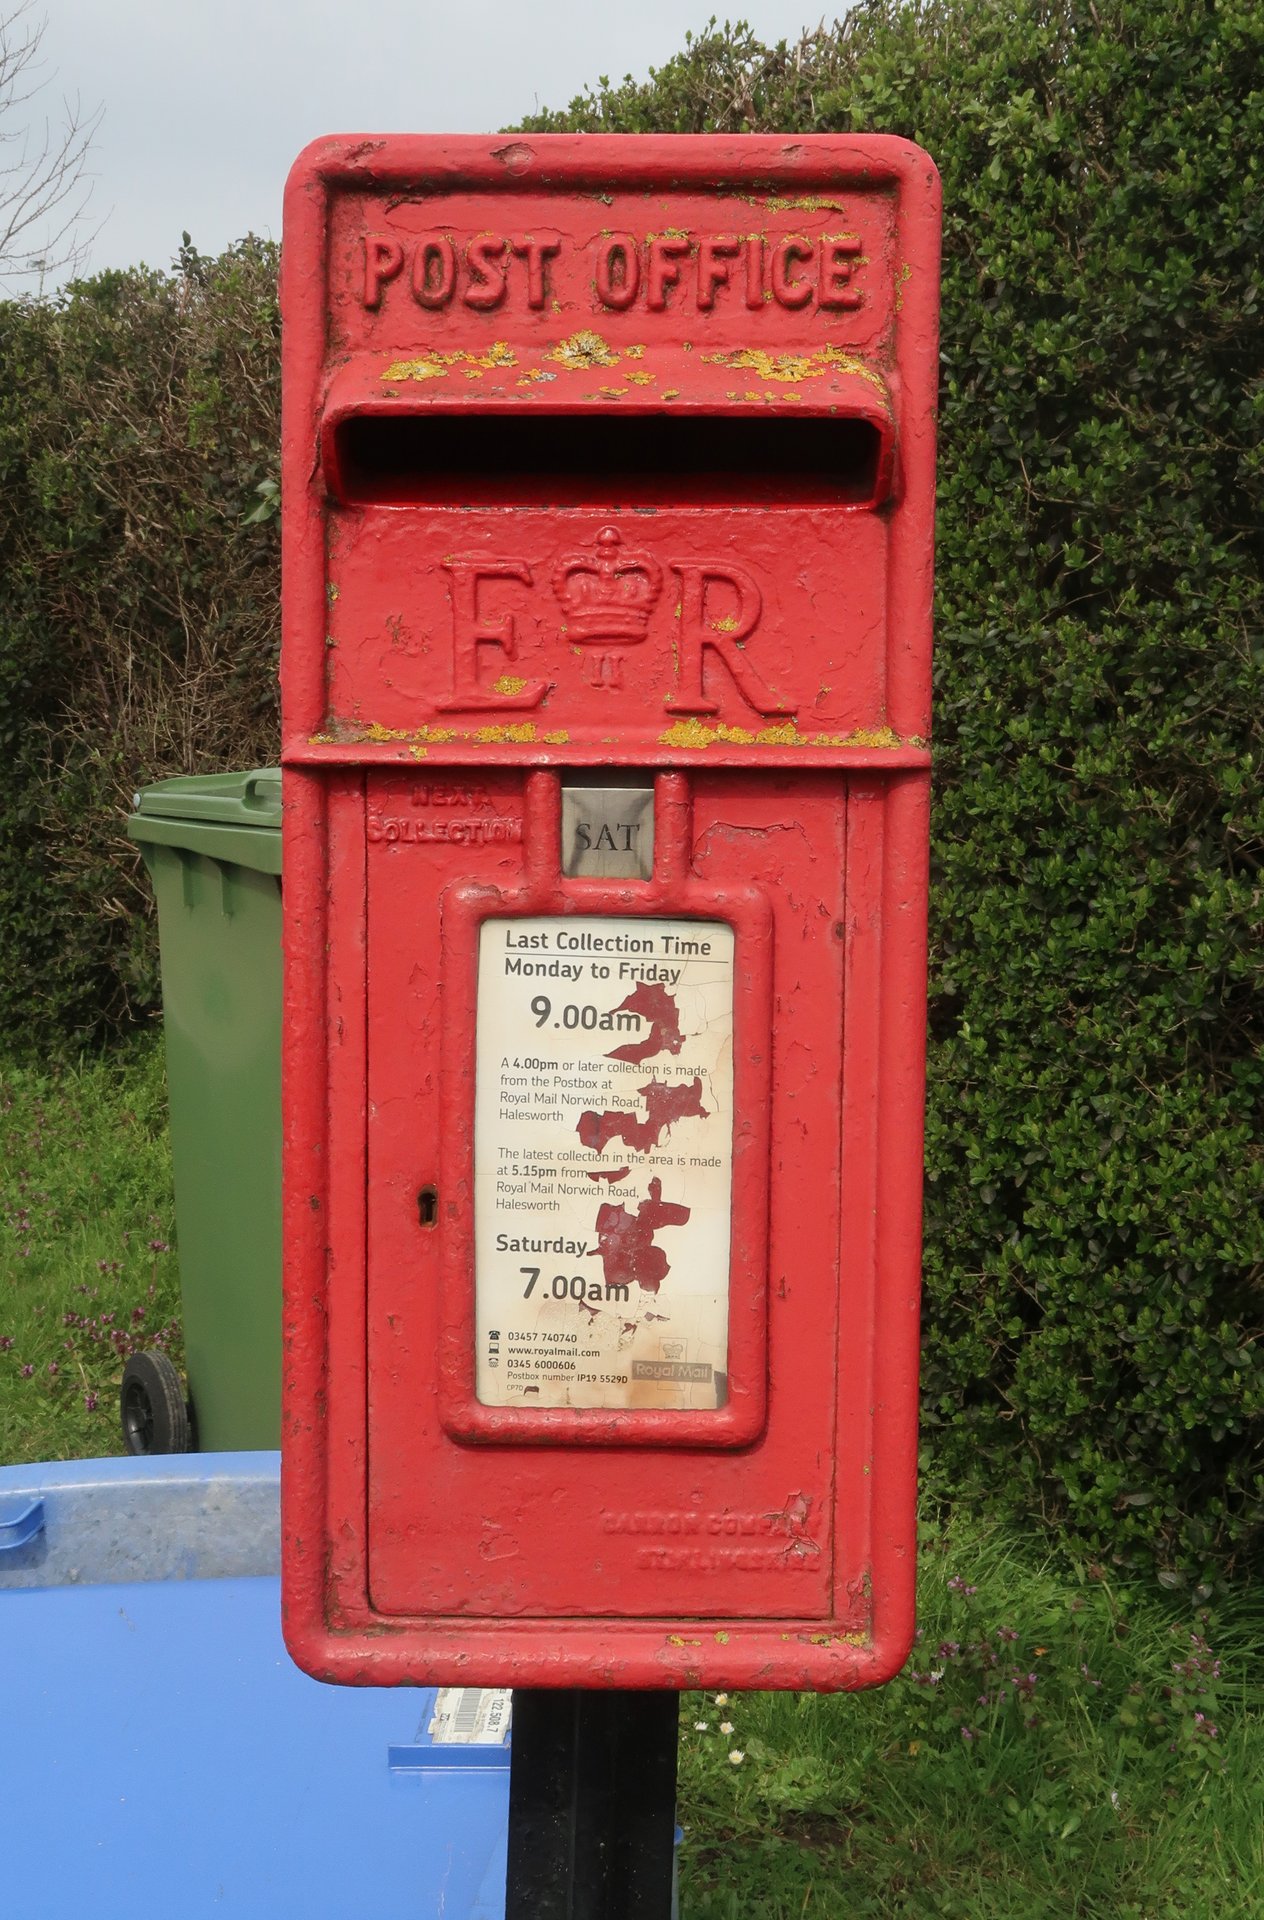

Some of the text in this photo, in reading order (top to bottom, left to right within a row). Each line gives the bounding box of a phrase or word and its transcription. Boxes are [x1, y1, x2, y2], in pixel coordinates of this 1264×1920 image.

[363, 234, 863, 310] POST OFFICE
[434, 560, 798, 715] E R
[367, 816, 522, 843] COLLECTION
[576, 823, 640, 851] SAT
[506, 930, 711, 955] Last Collection Time
[505, 958, 681, 985] Monday to Friday
[530, 995, 641, 1032] 9.00am
[501, 1058, 708, 1076] A 4.00pm or later collection is made
[500, 1075, 613, 1090] from the Postbox at
[500, 1092, 644, 1109] Royal Mail Norwich Road,
[499, 1109, 564, 1122] Halesworth
[498, 1147, 722, 1167] The latest collection in the area is made
[496, 1165, 588, 1180] at 5.15pm from
[496, 1181, 639, 1199] Royal Mail Norwich Road,
[496, 1198, 560, 1211] Halesworth
[496, 1233, 588, 1258] Saturday
[519, 1267, 629, 1302] 7.00am
[508, 1331, 577, 1343] 03457 740740
[508, 1347, 600, 1357] www.royalmail.com
[507, 1359, 576, 1370] 0345 6000606
[636, 1364, 708, 1378] Royal Mail
[507, 1371, 539, 1381] Postbox
[542, 1372, 574, 1382] number
[577, 1374, 597, 1383] IP19
